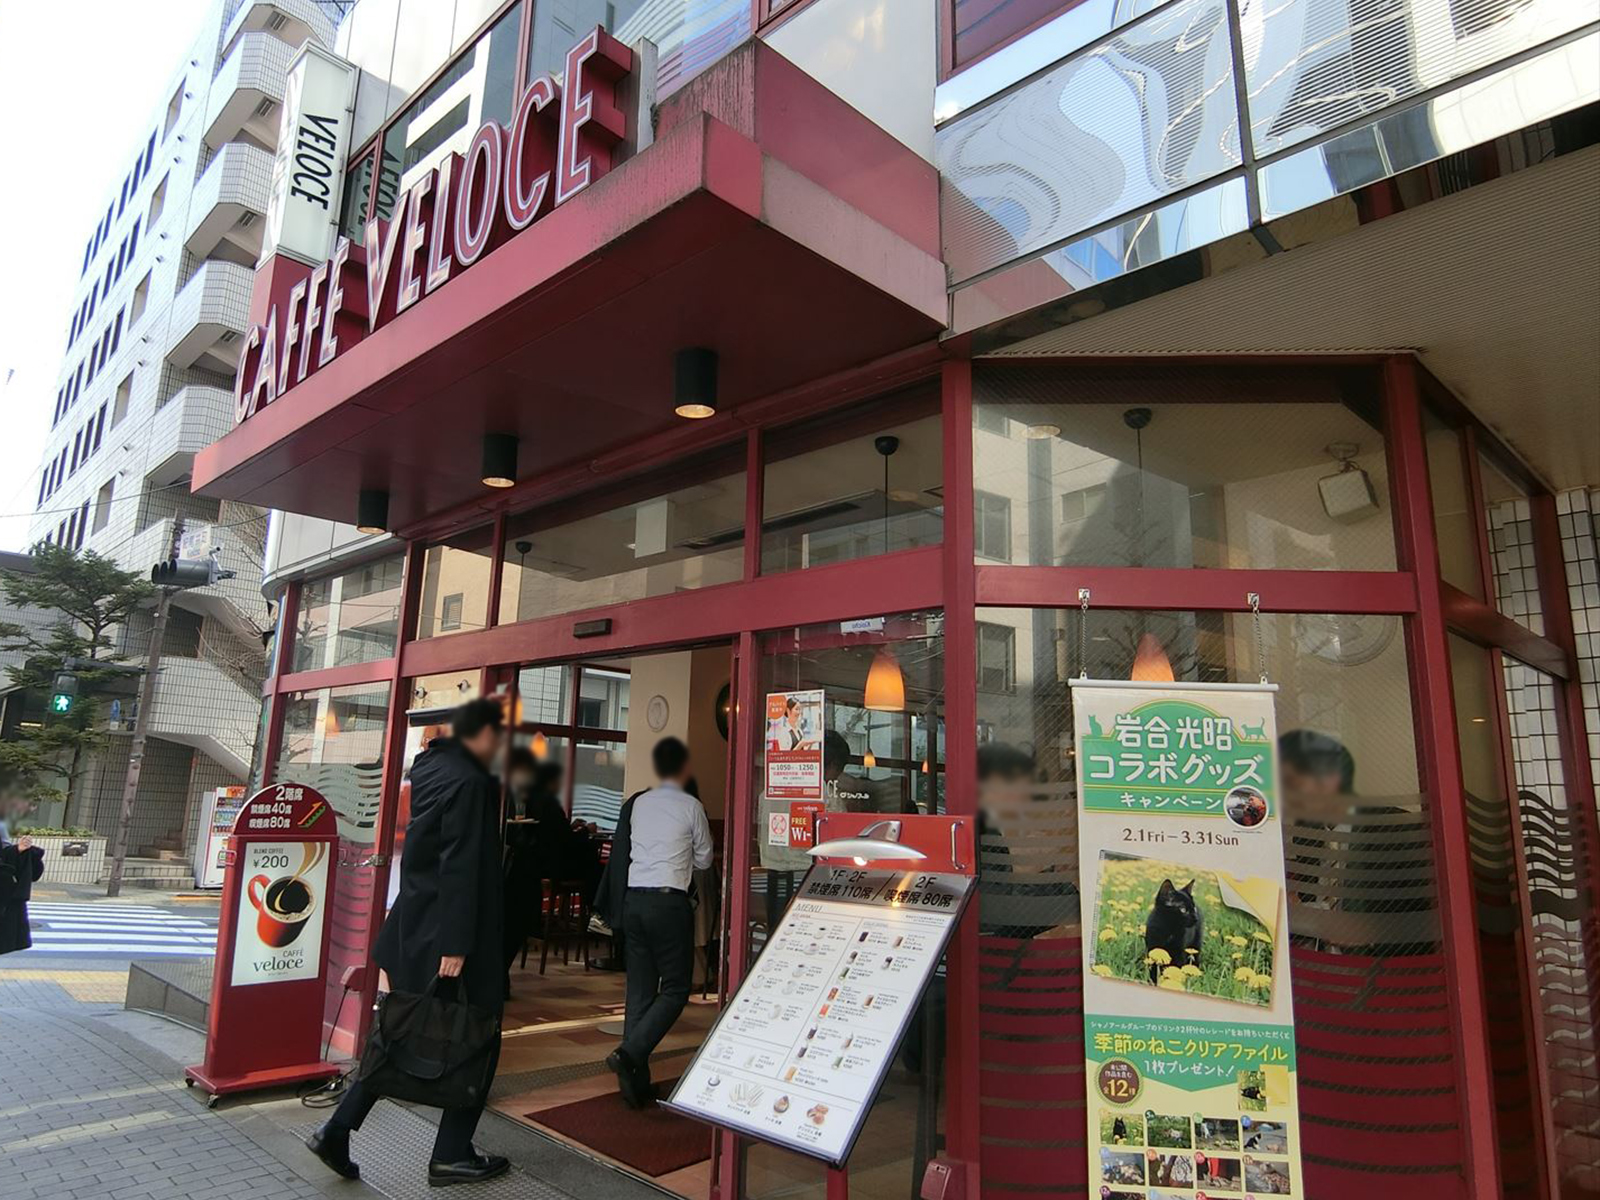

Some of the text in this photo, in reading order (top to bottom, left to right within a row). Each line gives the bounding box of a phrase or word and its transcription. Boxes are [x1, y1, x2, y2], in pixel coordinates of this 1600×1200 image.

[291, 113, 339, 210] VELOCE
[366, 24, 601, 334] VELOCE
[1115, 713, 1233, 751] 岩合 光昭
[1089, 751, 1265, 786] コラボグッズ
[275, 785, 304, 801] 2階席
[1119, 792, 1221, 810] キャンペーン
[791, 817, 807, 825] FREE
[253, 855, 289, 868] ¥200
[915, 876, 937, 889] 2F
[795, 903, 823, 913] MENU
[253, 956, 305, 972] veloce
[1093, 1032, 1289, 1062] 季節のねこクリアファイル
[1144, 1059, 1236, 1078] 1枚プレゼント！
